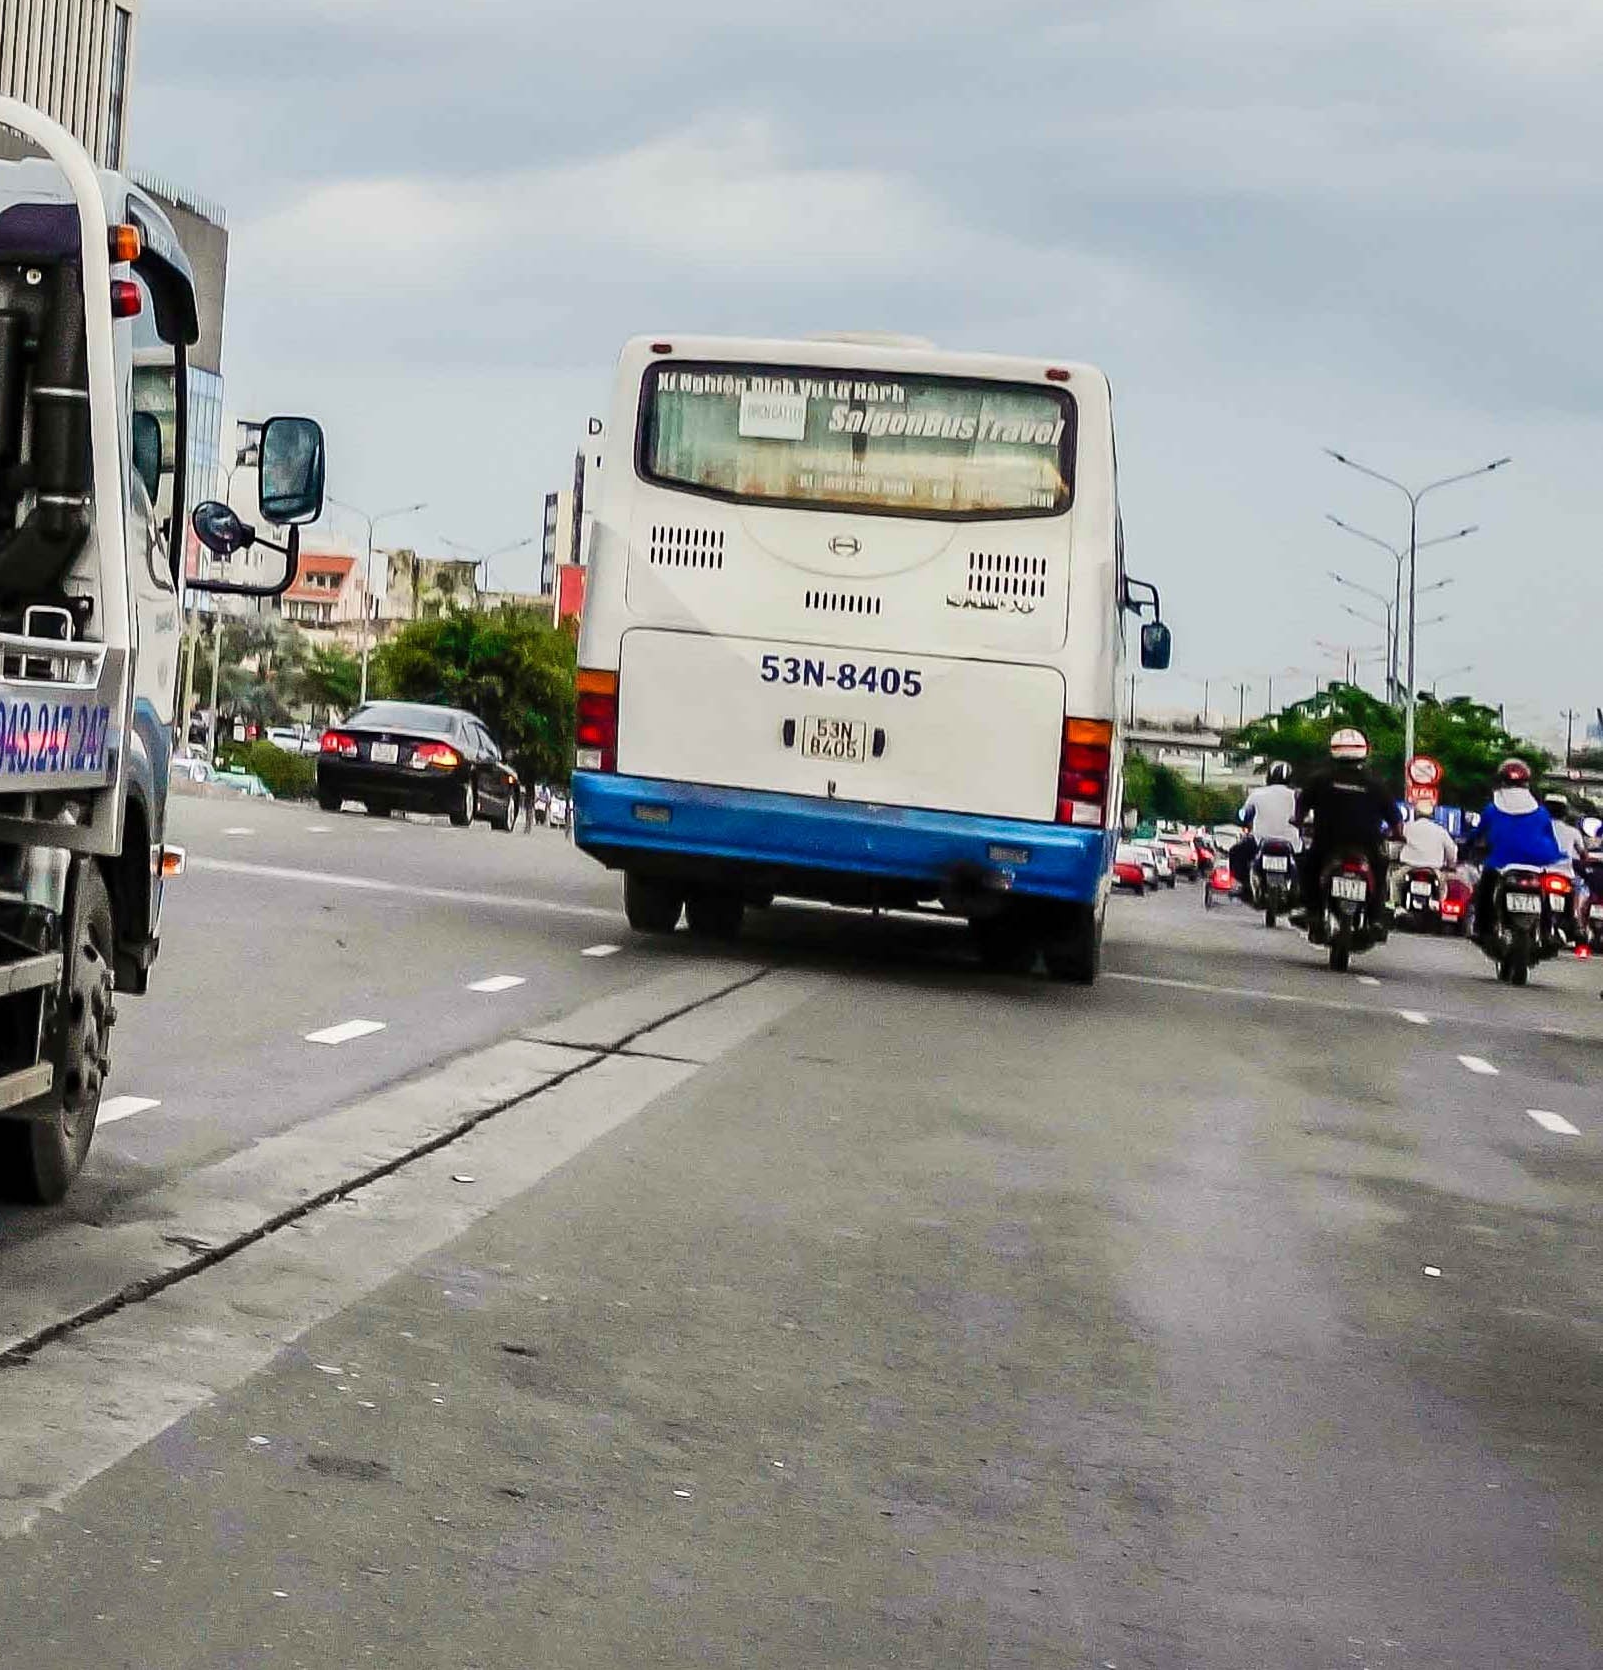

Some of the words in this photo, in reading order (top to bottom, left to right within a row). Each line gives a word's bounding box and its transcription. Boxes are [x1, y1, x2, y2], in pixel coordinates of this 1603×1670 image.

[761, 655, 922, 697] 53N-8405
[817, 718, 853, 740] 53N
[810, 735, 857, 758] 8405
